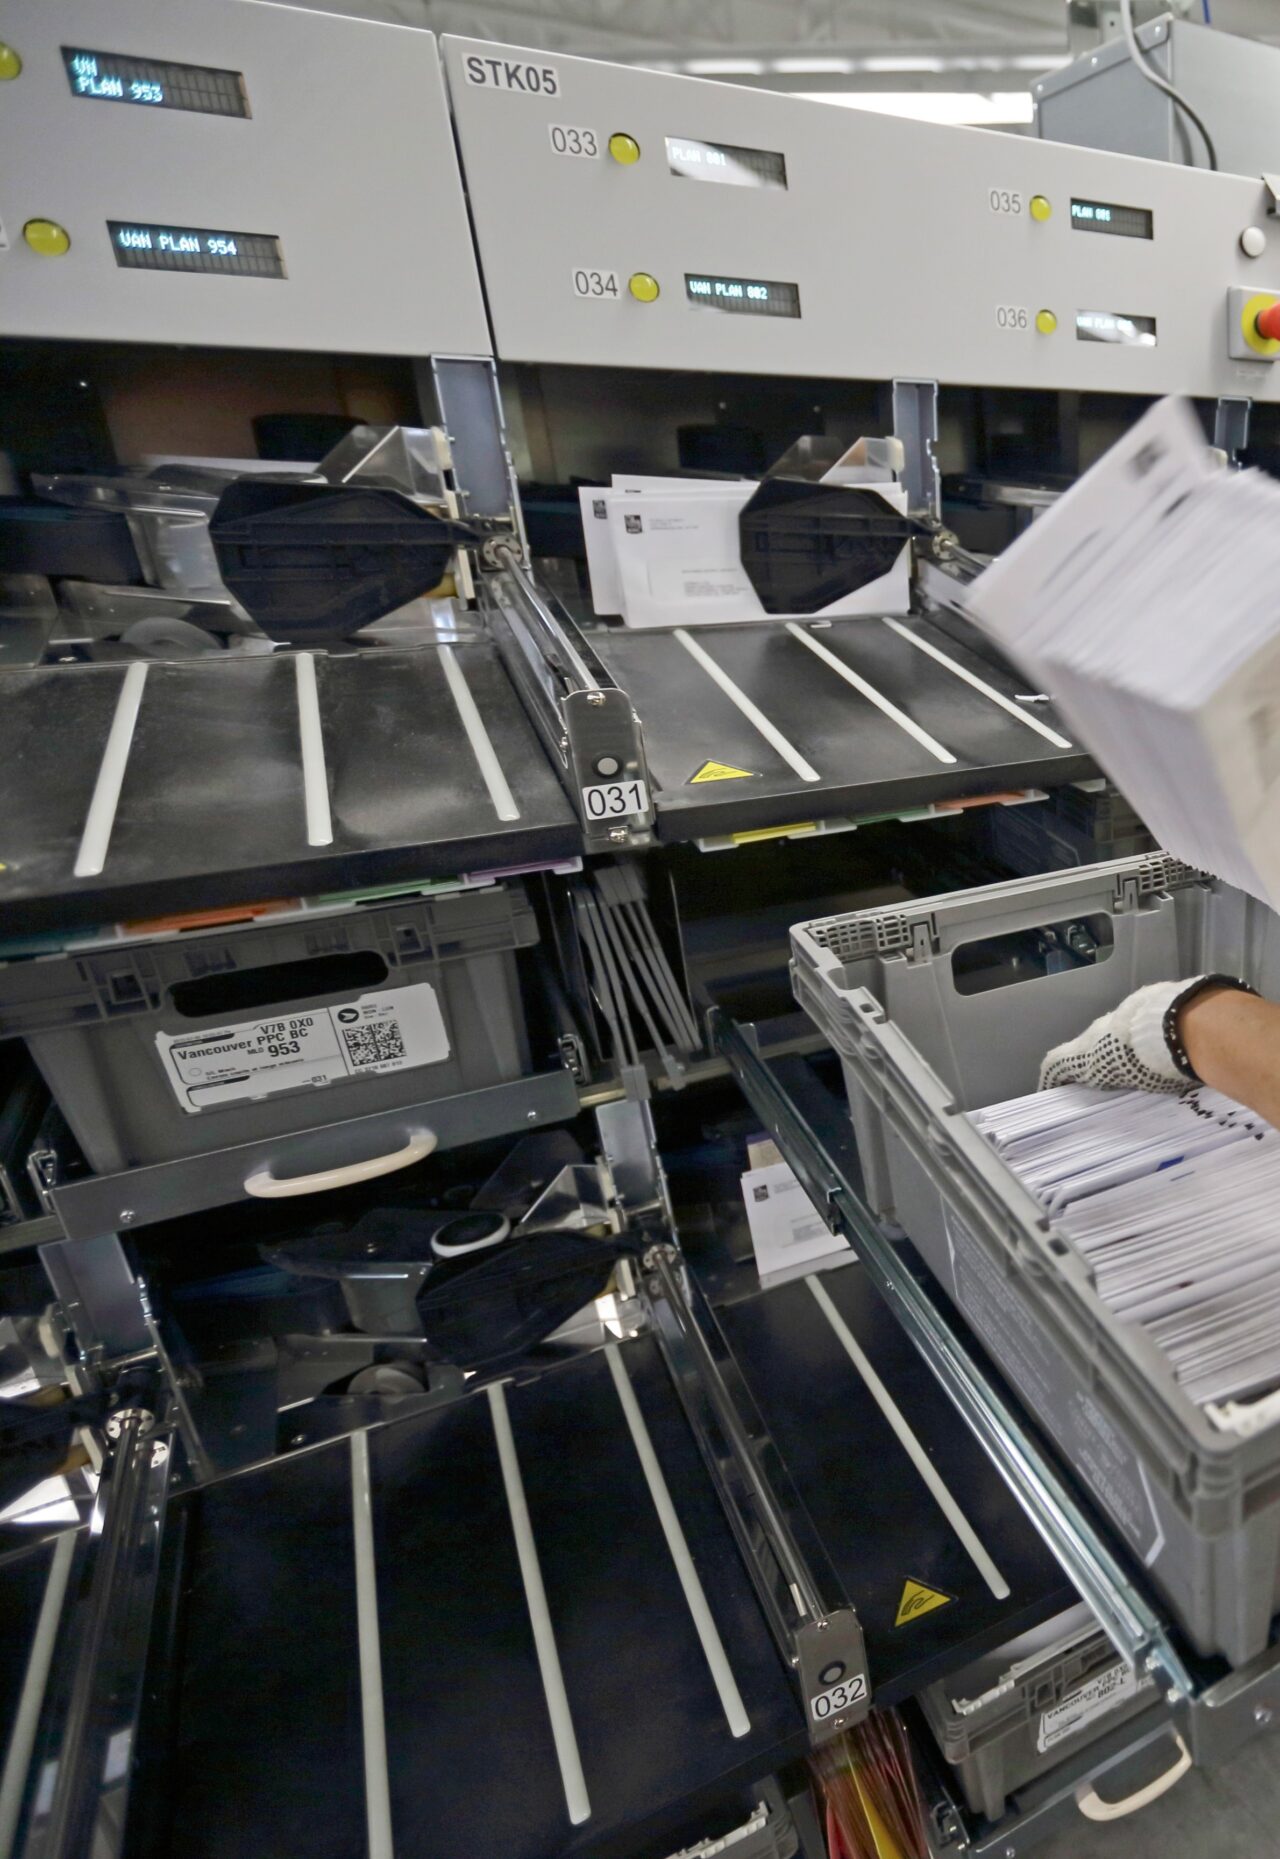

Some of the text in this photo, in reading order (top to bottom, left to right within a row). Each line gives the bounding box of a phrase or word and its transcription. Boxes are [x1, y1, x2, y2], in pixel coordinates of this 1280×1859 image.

[466, 56, 557, 95] STK05
[77, 76, 163, 102] PLAN 953
[551, 127, 597, 157] 033
[672, 147, 701, 163] PLAN
[990, 190, 1021, 214] 035
[119, 229, 237, 256] VAN PLAN 954
[575, 271, 618, 296] 034
[689, 280, 710, 296] VAN
[715, 283, 743, 298] PLAN
[997, 307, 1027, 329] 036
[587, 783, 643, 817] 031
[260, 1022, 286, 1035] V7B
[178, 1028, 308, 1060] Vancouver PPC BC
[268, 1041, 301, 1057] 953
[815, 1678, 865, 1717] 032
[1047, 1686, 1100, 1719] VANCOUVER
